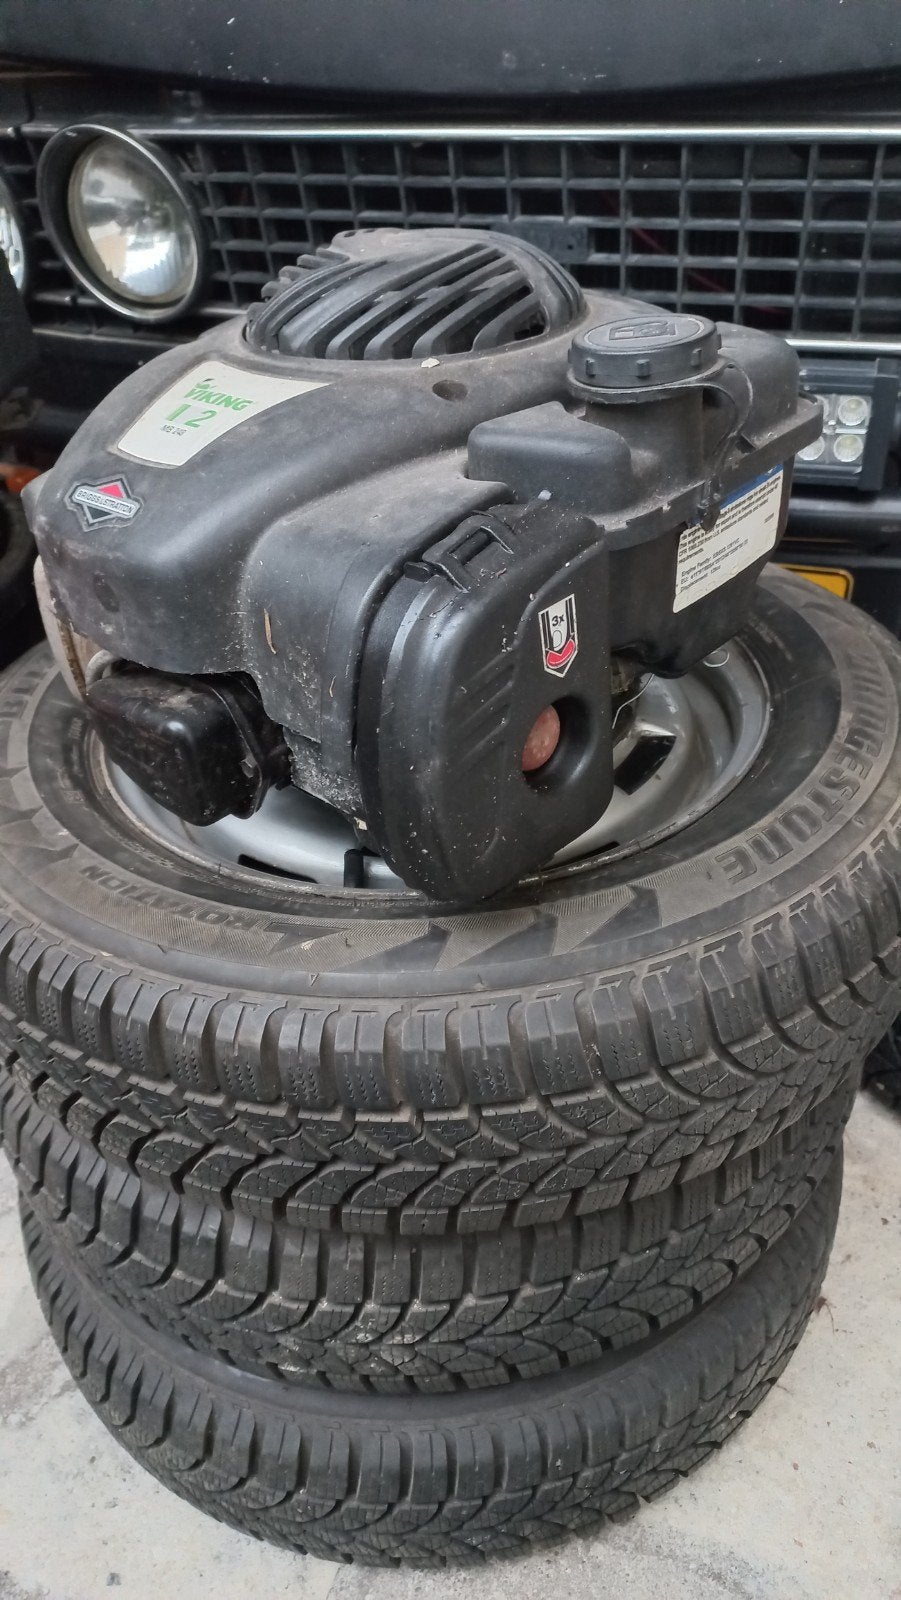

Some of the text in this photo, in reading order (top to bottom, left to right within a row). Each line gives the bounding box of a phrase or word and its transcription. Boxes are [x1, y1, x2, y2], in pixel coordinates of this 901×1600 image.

[184, 388, 254, 412] VIKING
[687, 535, 700, 544] engine
[681, 566, 695, 576] Engine
[551, 614, 565, 627] 3x
[79, 864, 259, 931] ROTATION
